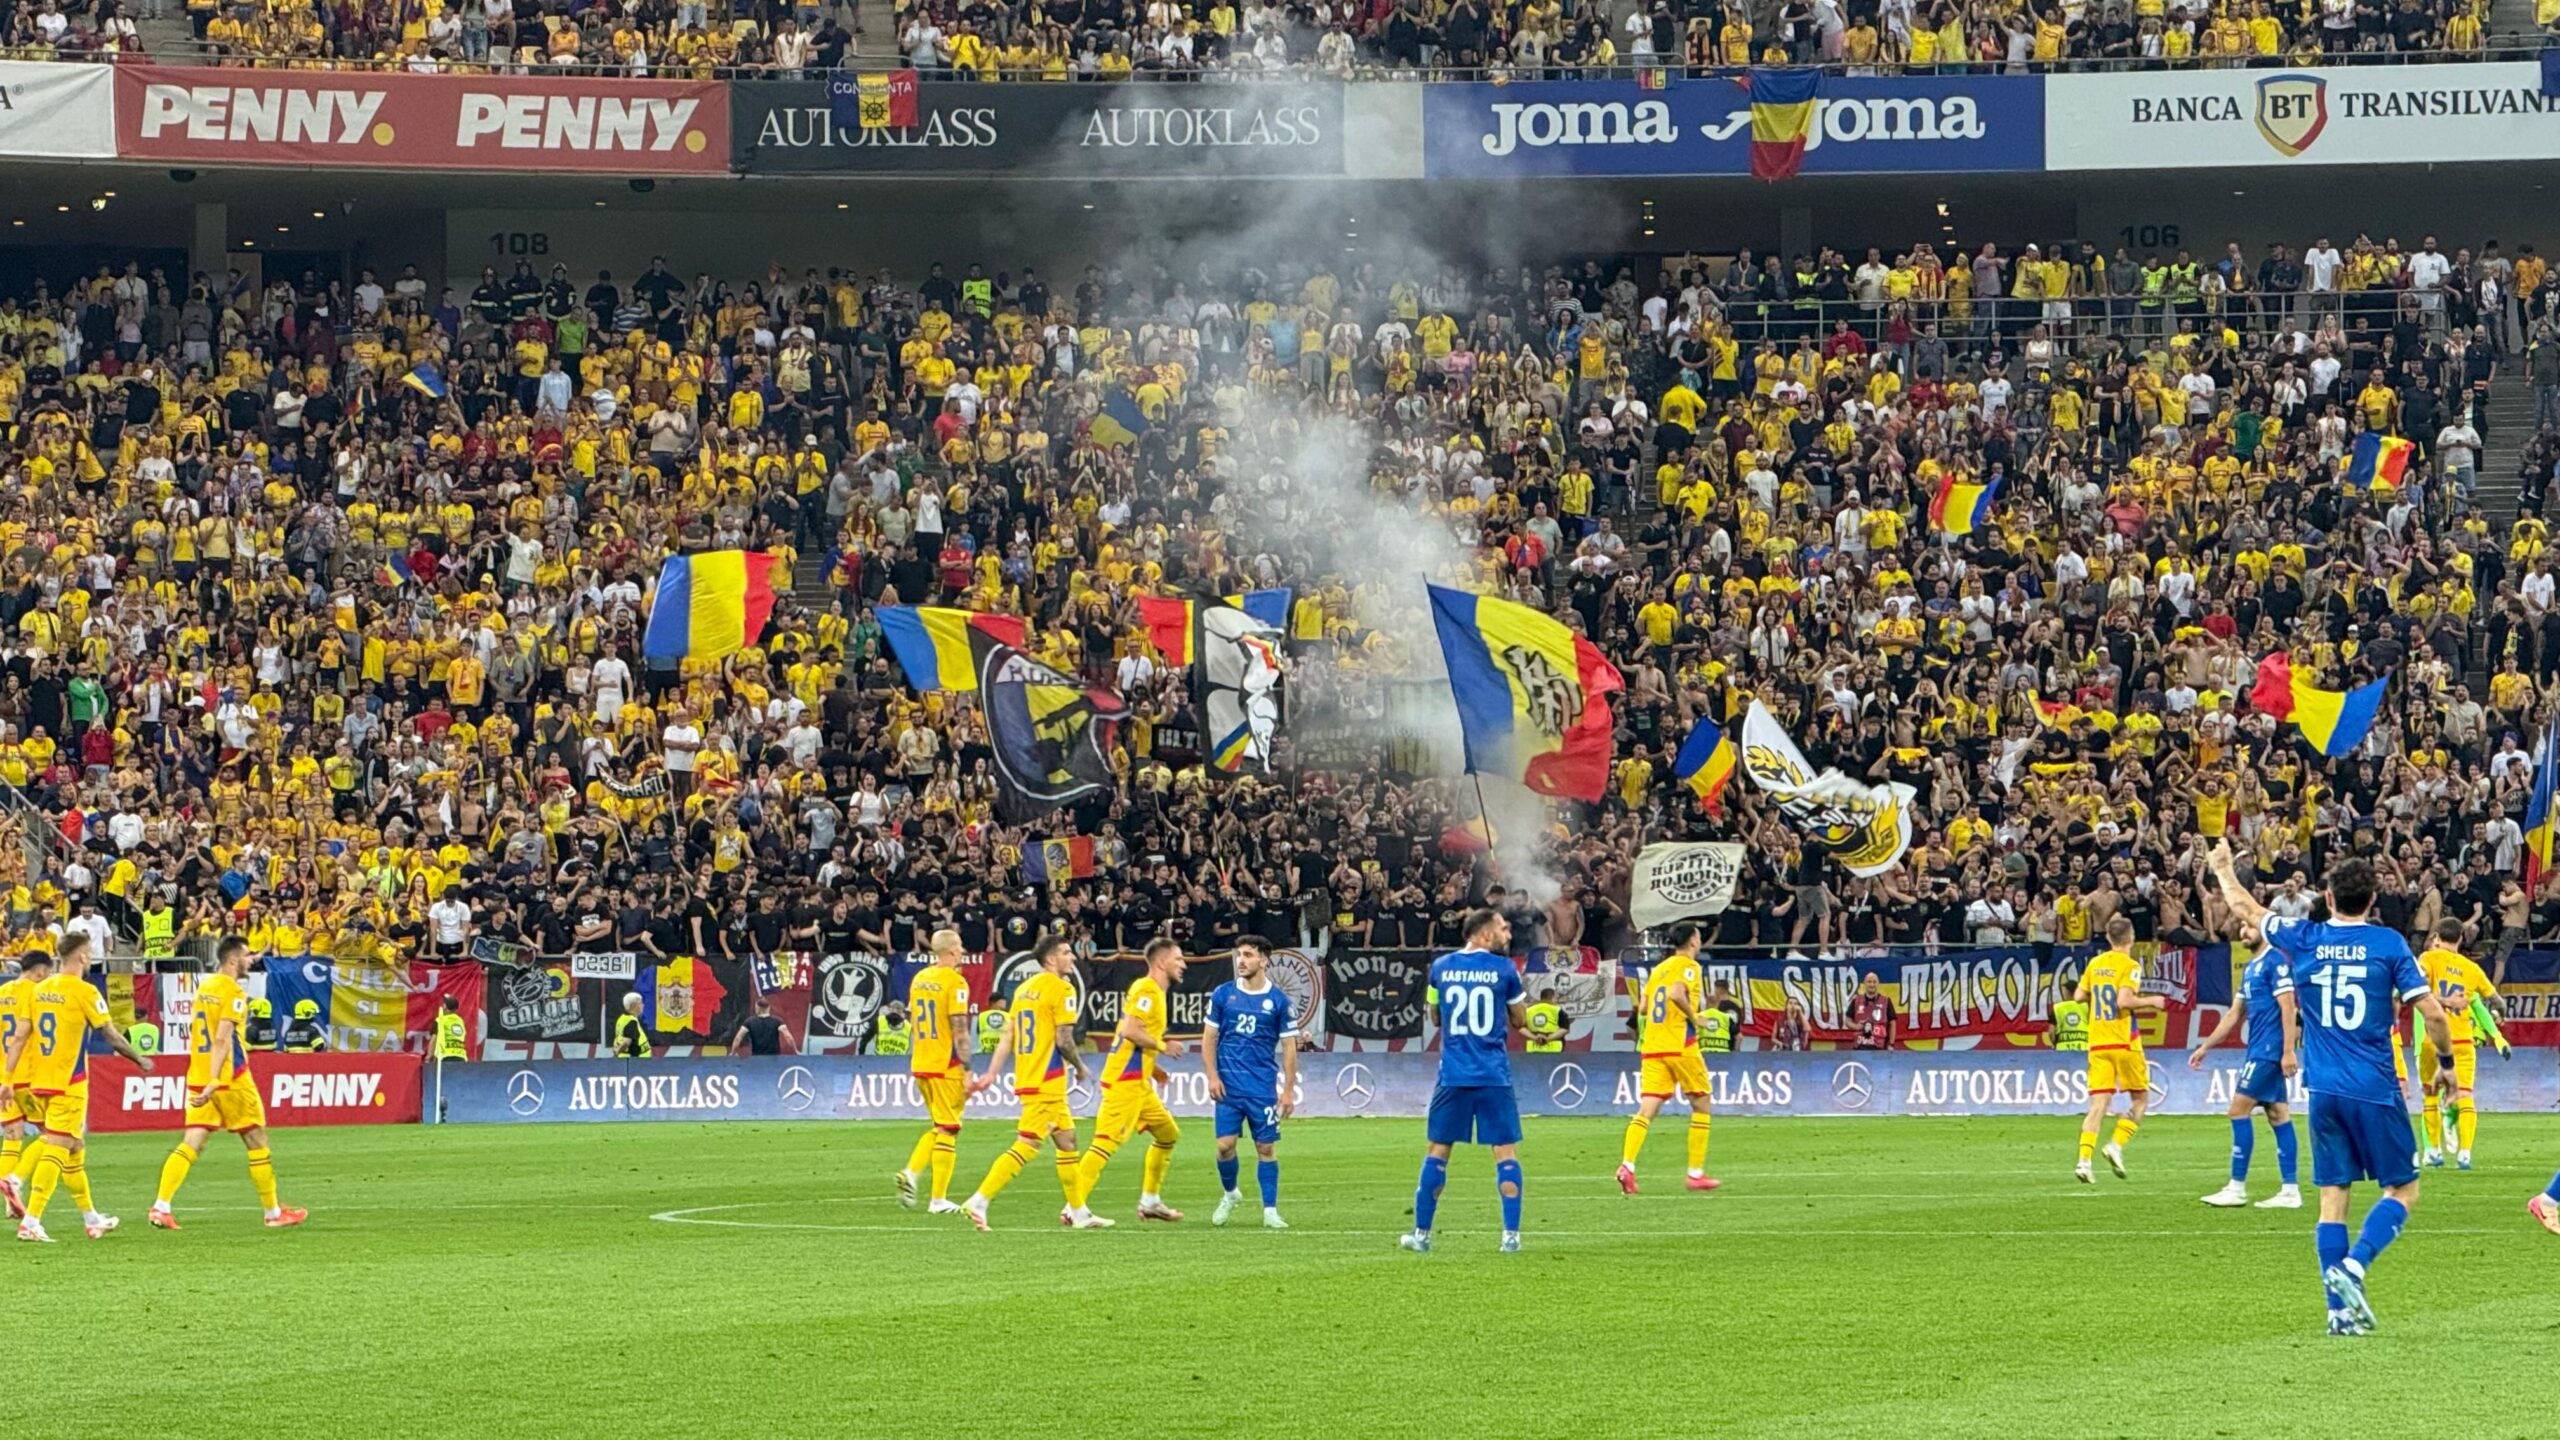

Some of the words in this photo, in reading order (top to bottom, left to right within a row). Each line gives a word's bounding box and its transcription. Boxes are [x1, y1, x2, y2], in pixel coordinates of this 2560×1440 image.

[2132, 94, 2242, 125] BANCA
[2271, 93, 2313, 120] BT
[1081, 106, 1320, 147] AUTOKLASS
[489, 232, 550, 256] 108
[2119, 225, 2180, 250] 106
[2315, 945, 2367, 961] SHELIS
[1369, 982, 1385, 1001] et
[1441, 970, 1500, 983] KASTANOS
[1445, 985, 1495, 1037] 20
[1652, 985, 1667, 1024] 8
[2092, 984, 2118, 1022] 19
[2310, 964, 2369, 1031] 15
[38, 1012, 57, 1056] 9
[917, 999, 938, 1040] 21
[1017, 1010, 1036, 1055] 13
[1235, 1013, 1256, 1034] 23
[568, 1074, 740, 1111] AUTOKLASS
[1906, 1069, 2090, 1105] AUTOKLASS
